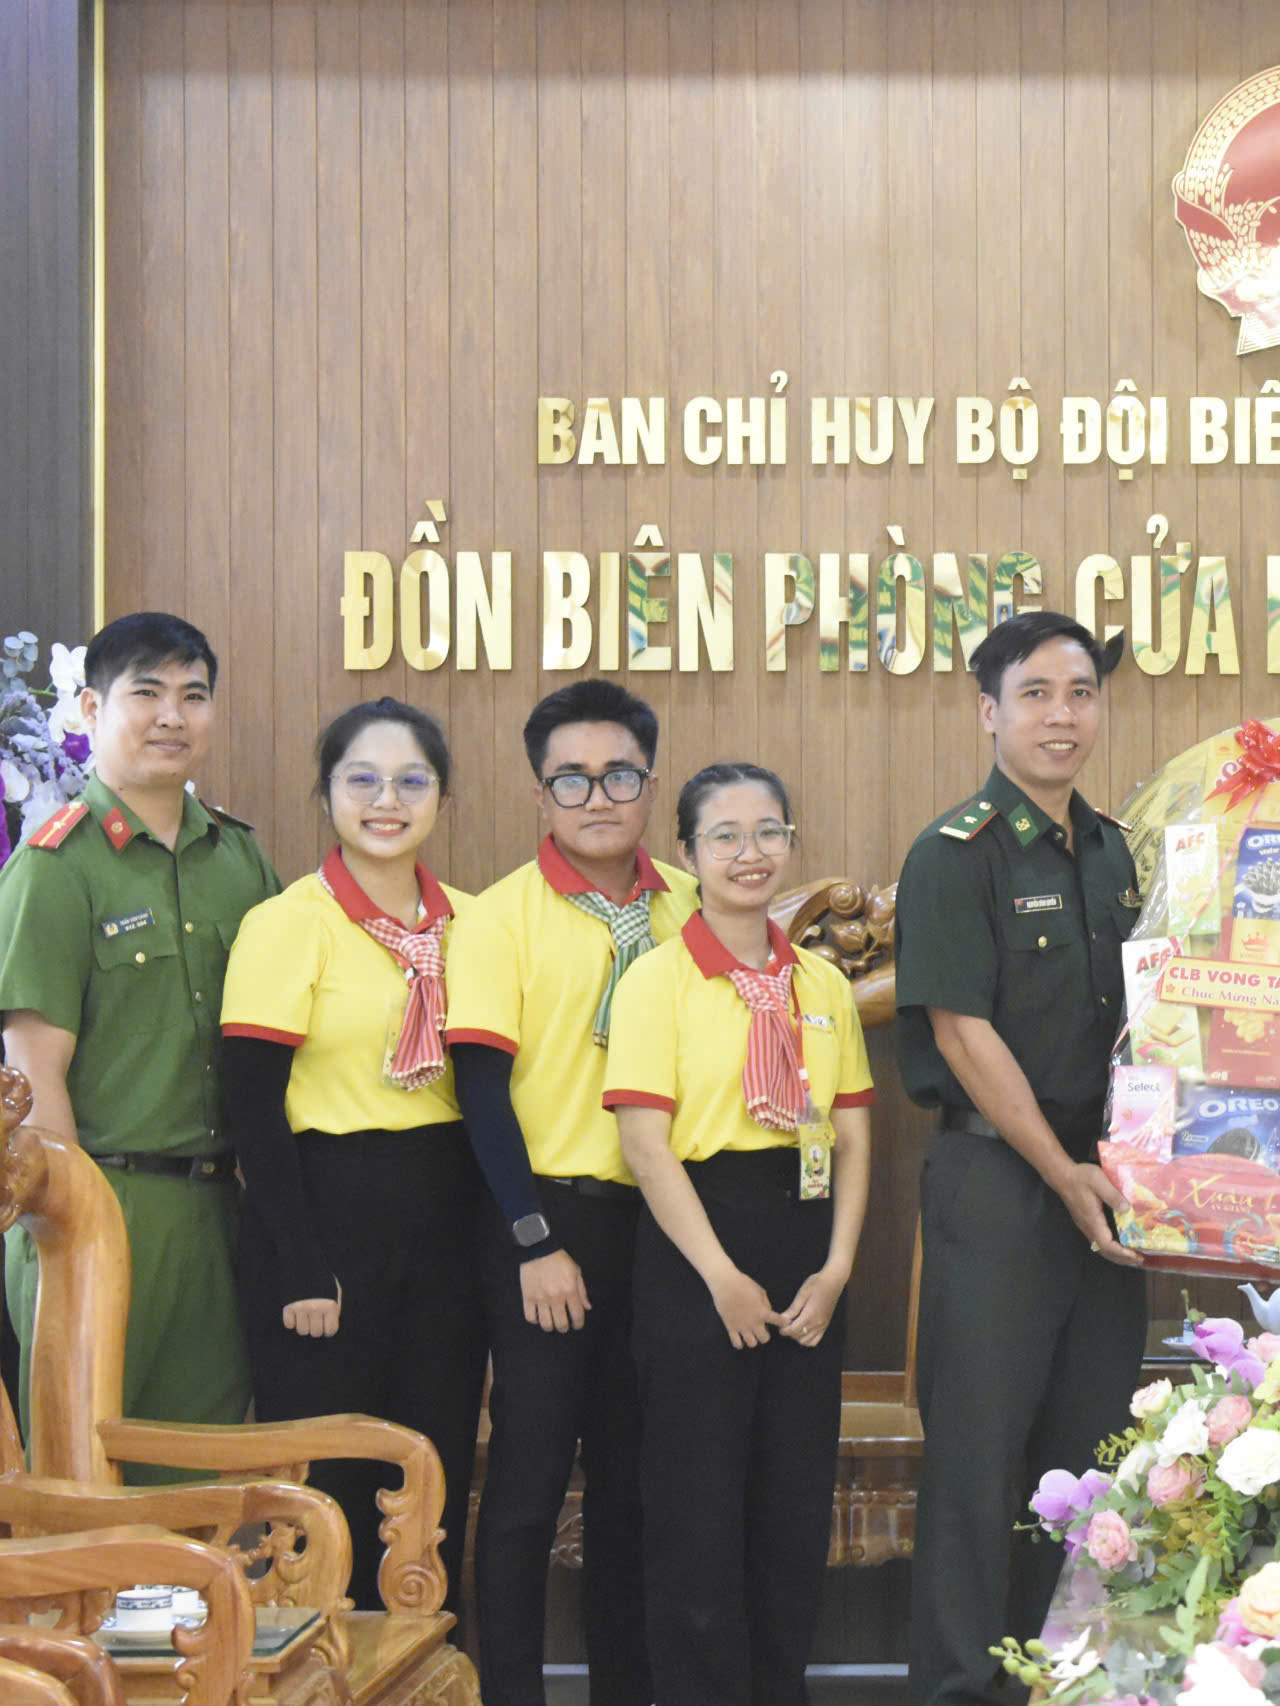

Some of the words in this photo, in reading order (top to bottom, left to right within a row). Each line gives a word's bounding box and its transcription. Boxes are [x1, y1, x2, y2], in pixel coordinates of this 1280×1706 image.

[538, 397, 665, 465] BAN
[684, 369, 788, 465] CHỈ
[811, 397, 934, 465] HUY
[956, 376, 1039, 480] BỘ
[1060, 378, 1167, 480] ĐỘI
[340, 499, 512, 671] ĐỒN
[542, 524, 734, 672] BIÊN
[1074, 514, 1241, 676] CỬA
[1169, 966, 1201, 981] CLB
[1127, 1081, 1161, 1092] Select
[1199, 1097, 1280, 1118] OREO
